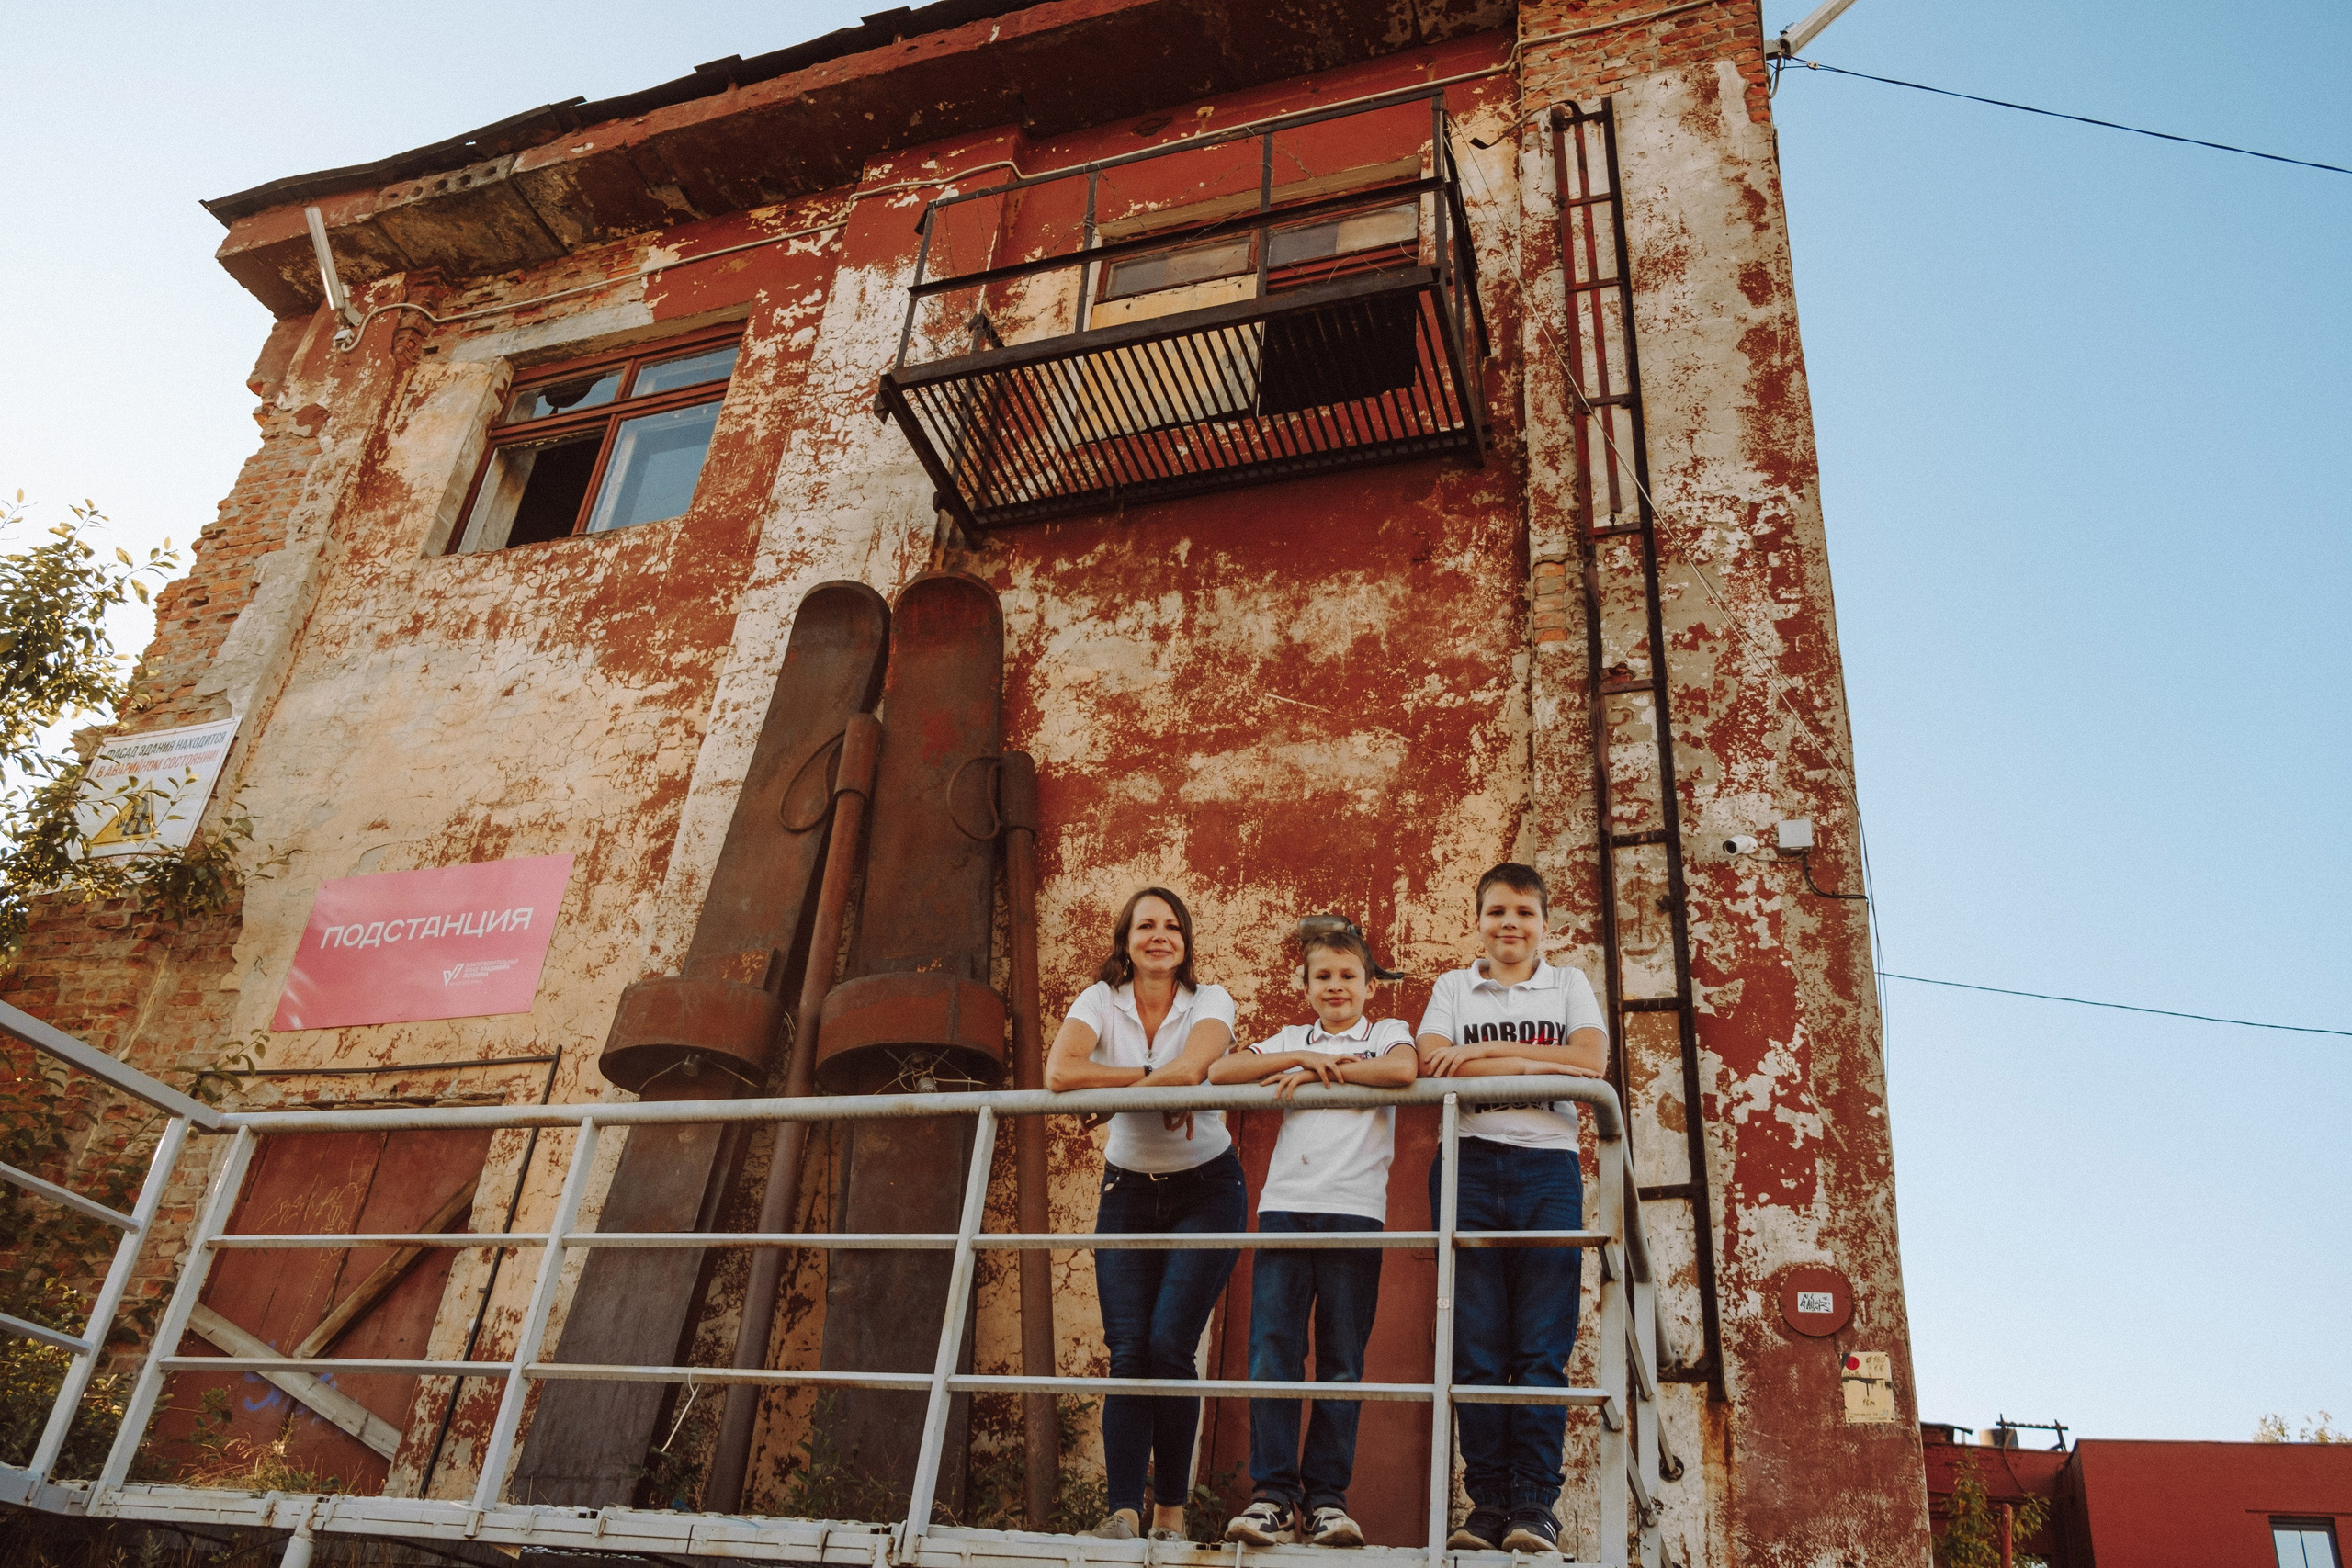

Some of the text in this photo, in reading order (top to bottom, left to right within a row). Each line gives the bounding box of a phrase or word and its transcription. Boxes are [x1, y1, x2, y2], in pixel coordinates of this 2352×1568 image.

[107, 731, 227, 759] ФАСАД ЗДАНИЯ НАХОДИТСЯ
[96, 750, 220, 778] В АВАРИЙНОМ СОСТОЯНИИ!
[320, 906, 534, 949] ПОДСТАНЦИЯ
[1464, 1020, 1566, 1045] NOBODY
